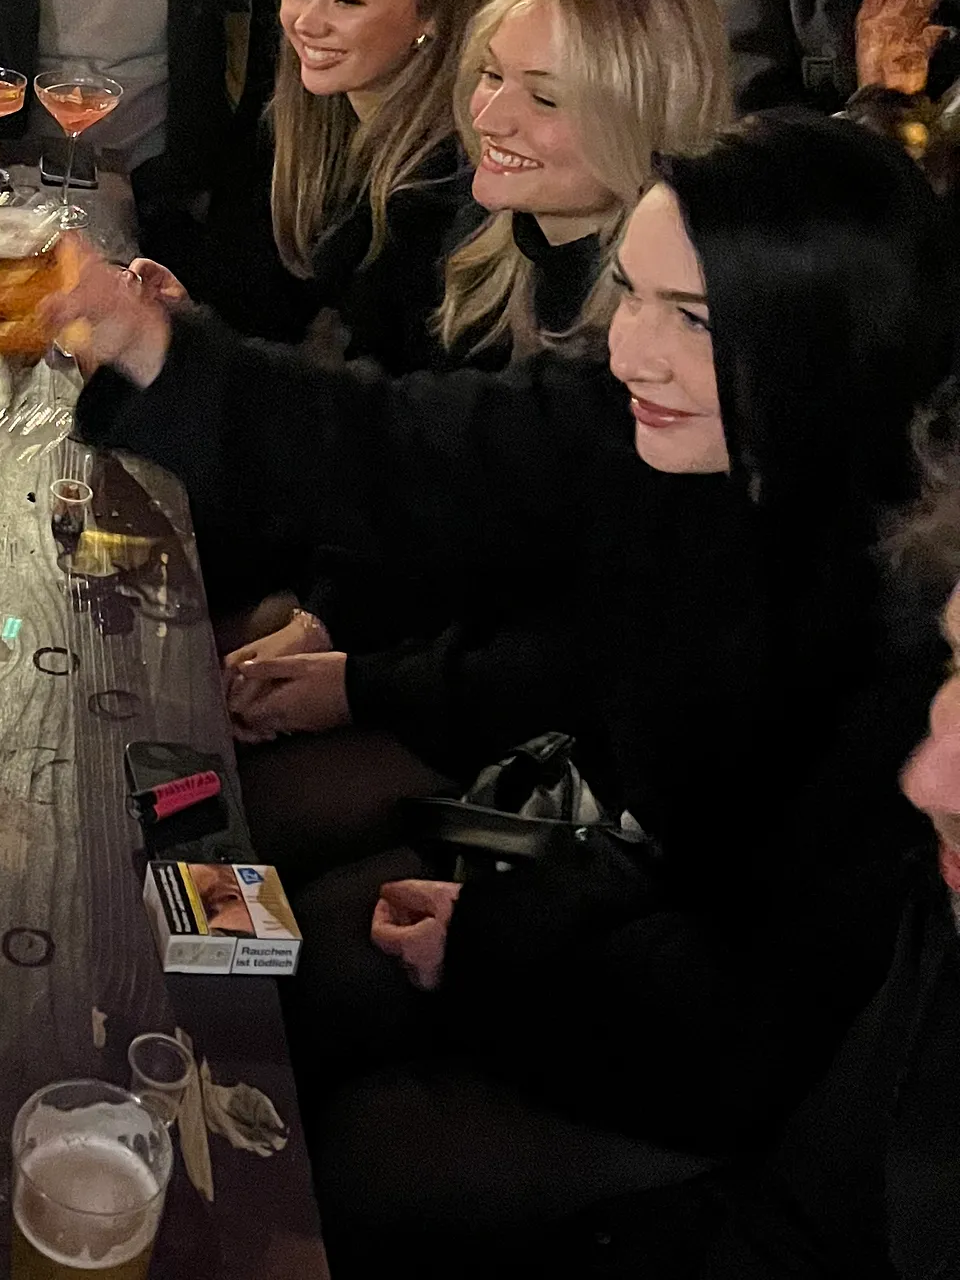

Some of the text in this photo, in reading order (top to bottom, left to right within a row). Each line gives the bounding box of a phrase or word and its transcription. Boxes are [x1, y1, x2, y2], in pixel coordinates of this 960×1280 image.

[241, 946, 293, 956] Rauchen
[236, 958, 293, 967] ist tödlich
